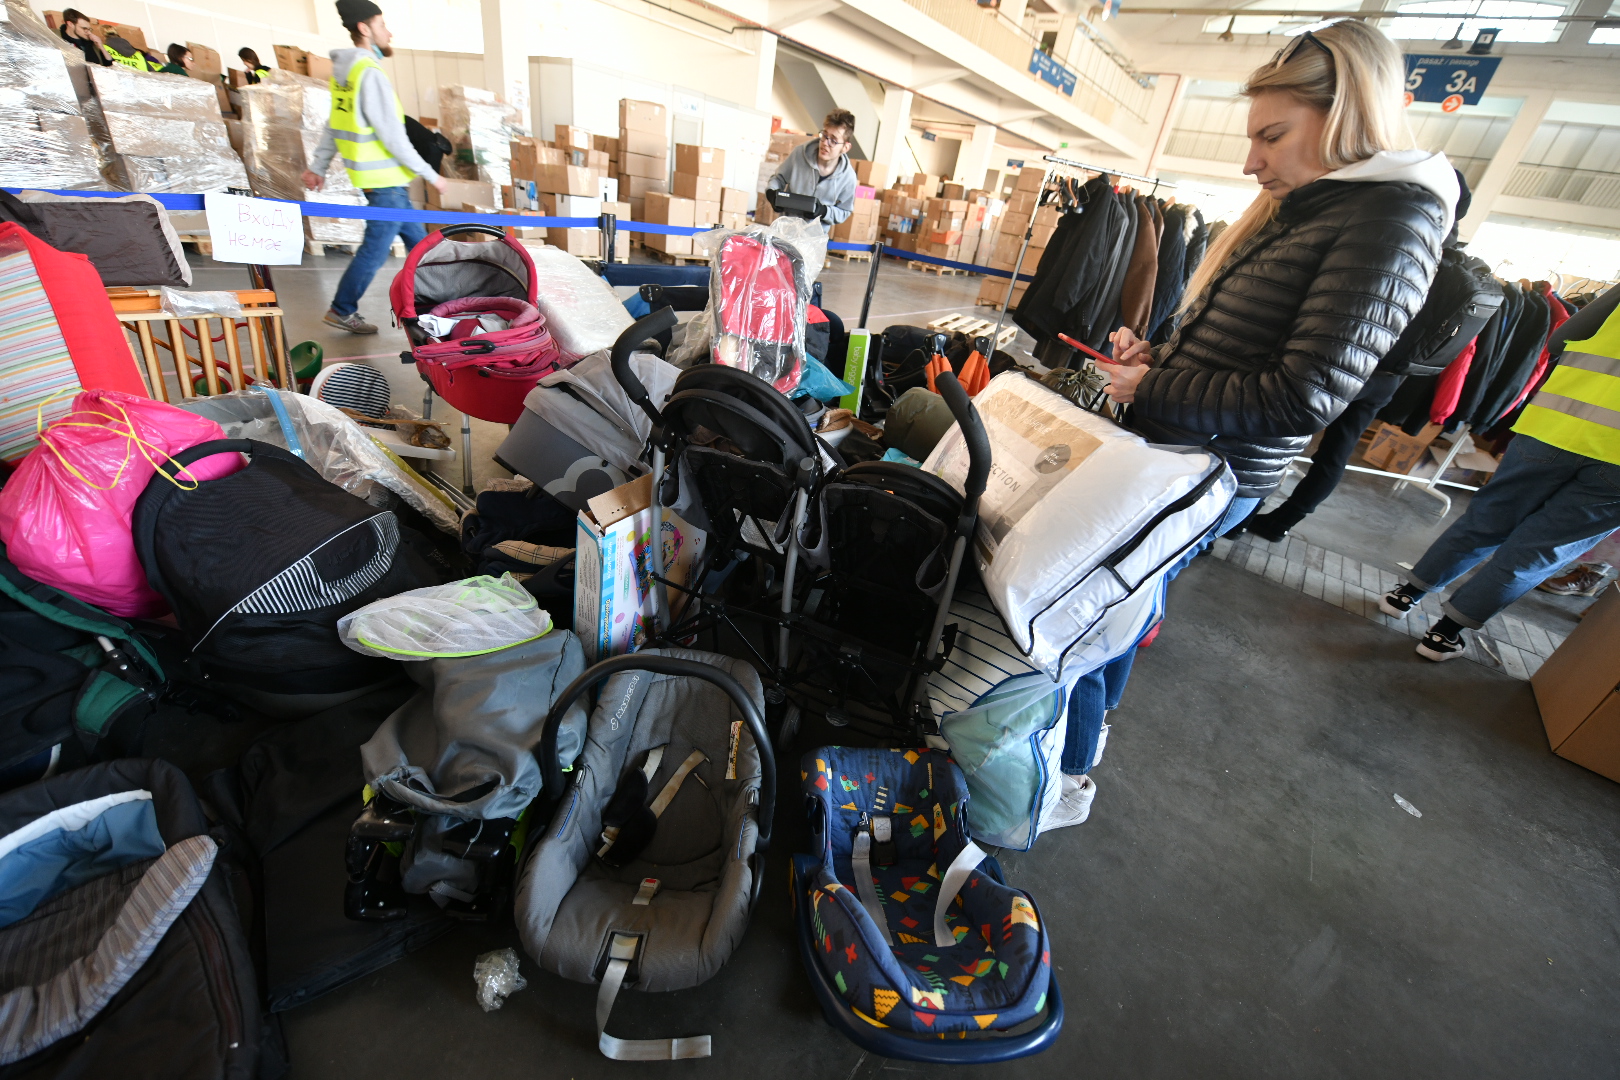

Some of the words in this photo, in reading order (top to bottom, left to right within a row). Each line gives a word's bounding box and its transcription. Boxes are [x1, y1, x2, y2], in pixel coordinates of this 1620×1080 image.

[1449, 57, 1480, 68] passage
[1405, 67, 1427, 91] 5
[1444, 69, 1478, 94] 3A
[851, 345, 863, 365] baby
[847, 363, 858, 387] jogge
